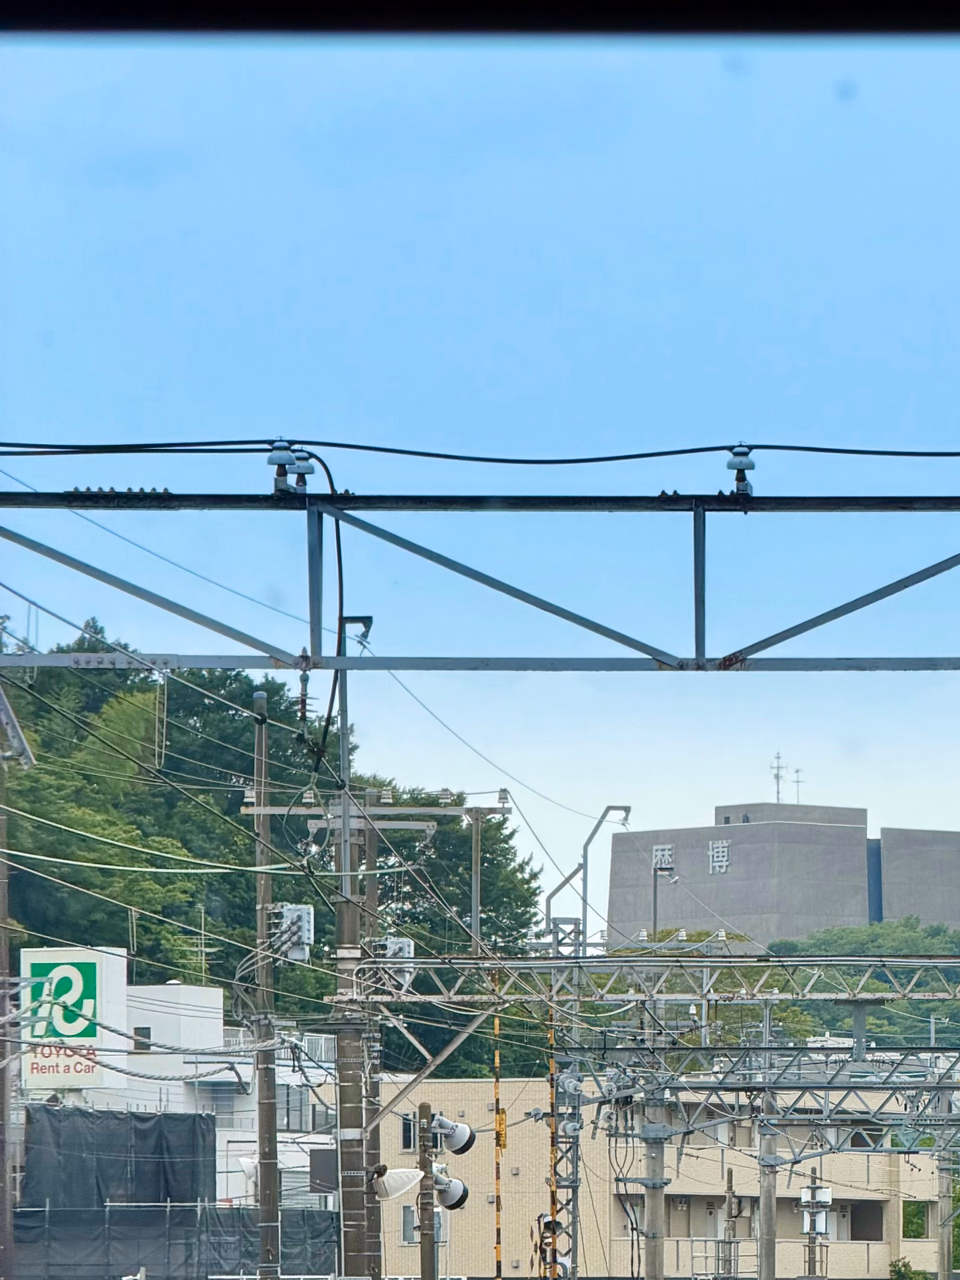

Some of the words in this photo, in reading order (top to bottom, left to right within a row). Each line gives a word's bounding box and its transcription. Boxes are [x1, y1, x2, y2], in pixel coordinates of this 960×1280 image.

[651, 840, 731, 875] 歴博
[31, 1045, 97, 1059] TOYOA
[30, 1062, 60, 1074] Rent
[63, 1064, 71, 1074] a
[73, 1061, 96, 1074] Car
